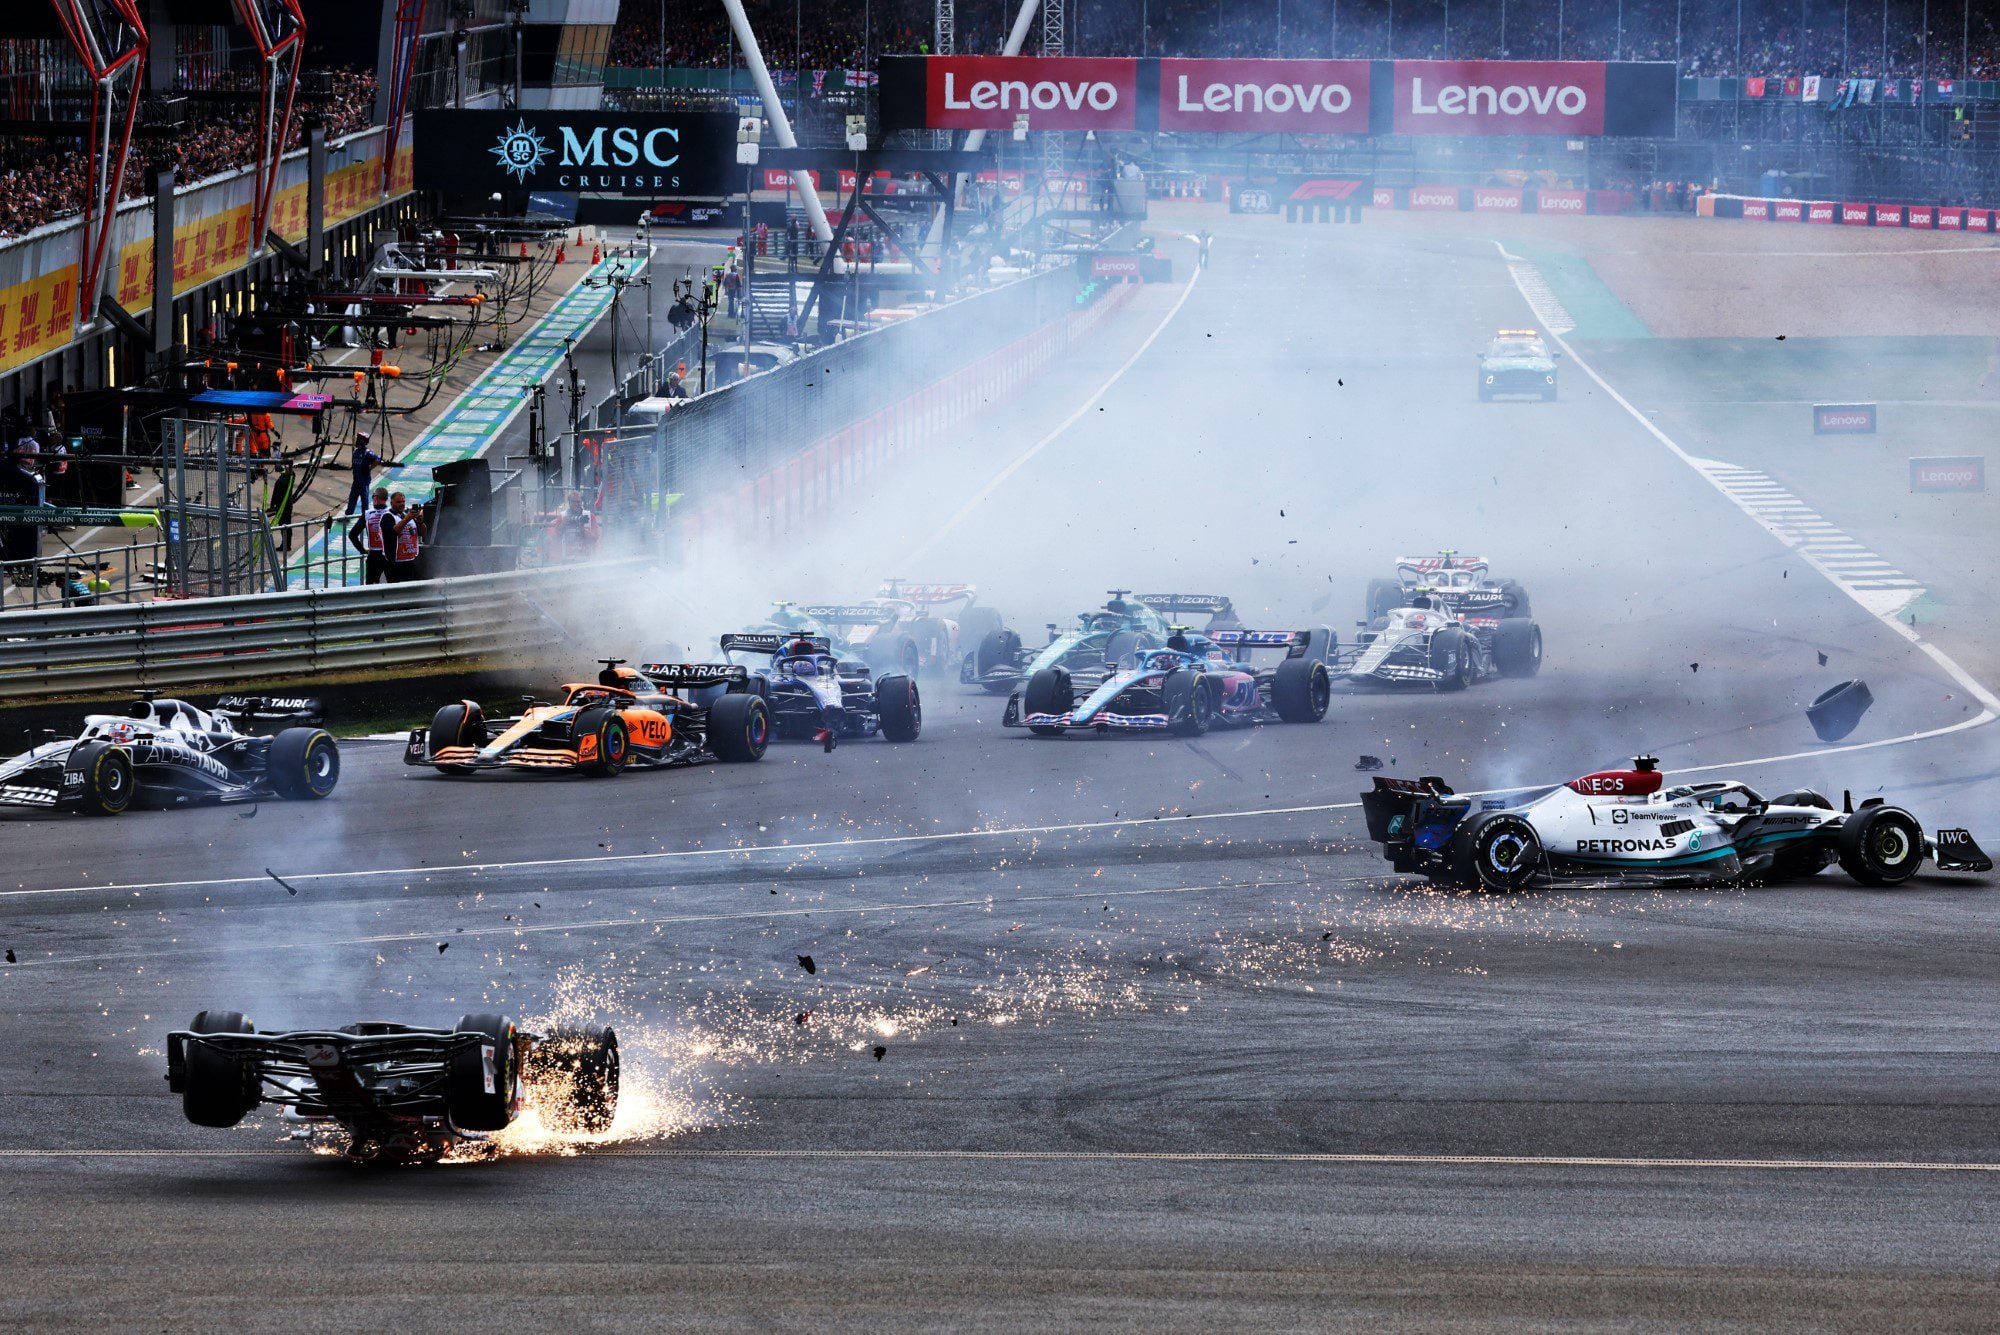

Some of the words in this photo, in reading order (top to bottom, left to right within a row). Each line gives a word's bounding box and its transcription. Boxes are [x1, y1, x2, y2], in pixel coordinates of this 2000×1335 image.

[945, 72, 1117, 110] Lenovo
[1178, 75, 1351, 113] Lenovo
[1412, 77, 1587, 116] Lenovo
[559, 126, 680, 168] MSC
[559, 175, 680, 187] CRUISES
[769, 172, 815, 186] Leno
[1412, 193, 1454, 206] Lenovo
[1476, 194, 1518, 208] Lenovo
[1541, 196, 1583, 210] Lenovo
[1743, 204, 1766, 216] Lenovo
[1842, 208, 1867, 220] Lenovo
[1876, 210, 1900, 223] Lenovo
[1095, 260, 1136, 271] Lenovo
[1823, 415, 1866, 426] Lenovo
[1921, 470, 1972, 483] Lenovo
[640, 720, 666, 740] VELO
[146, 744, 229, 780] ALPHATAURI
[64, 772, 86, 786] ZIBA
[1577, 778, 1625, 791] INEOS
[1630, 812, 1678, 821] TeamViewer
[1781, 816, 1822, 825] AMG
[1479, 817, 1505, 840] ZERO
[1940, 832, 1968, 844] IWC
[1576, 838, 1677, 853] PETRONAS
